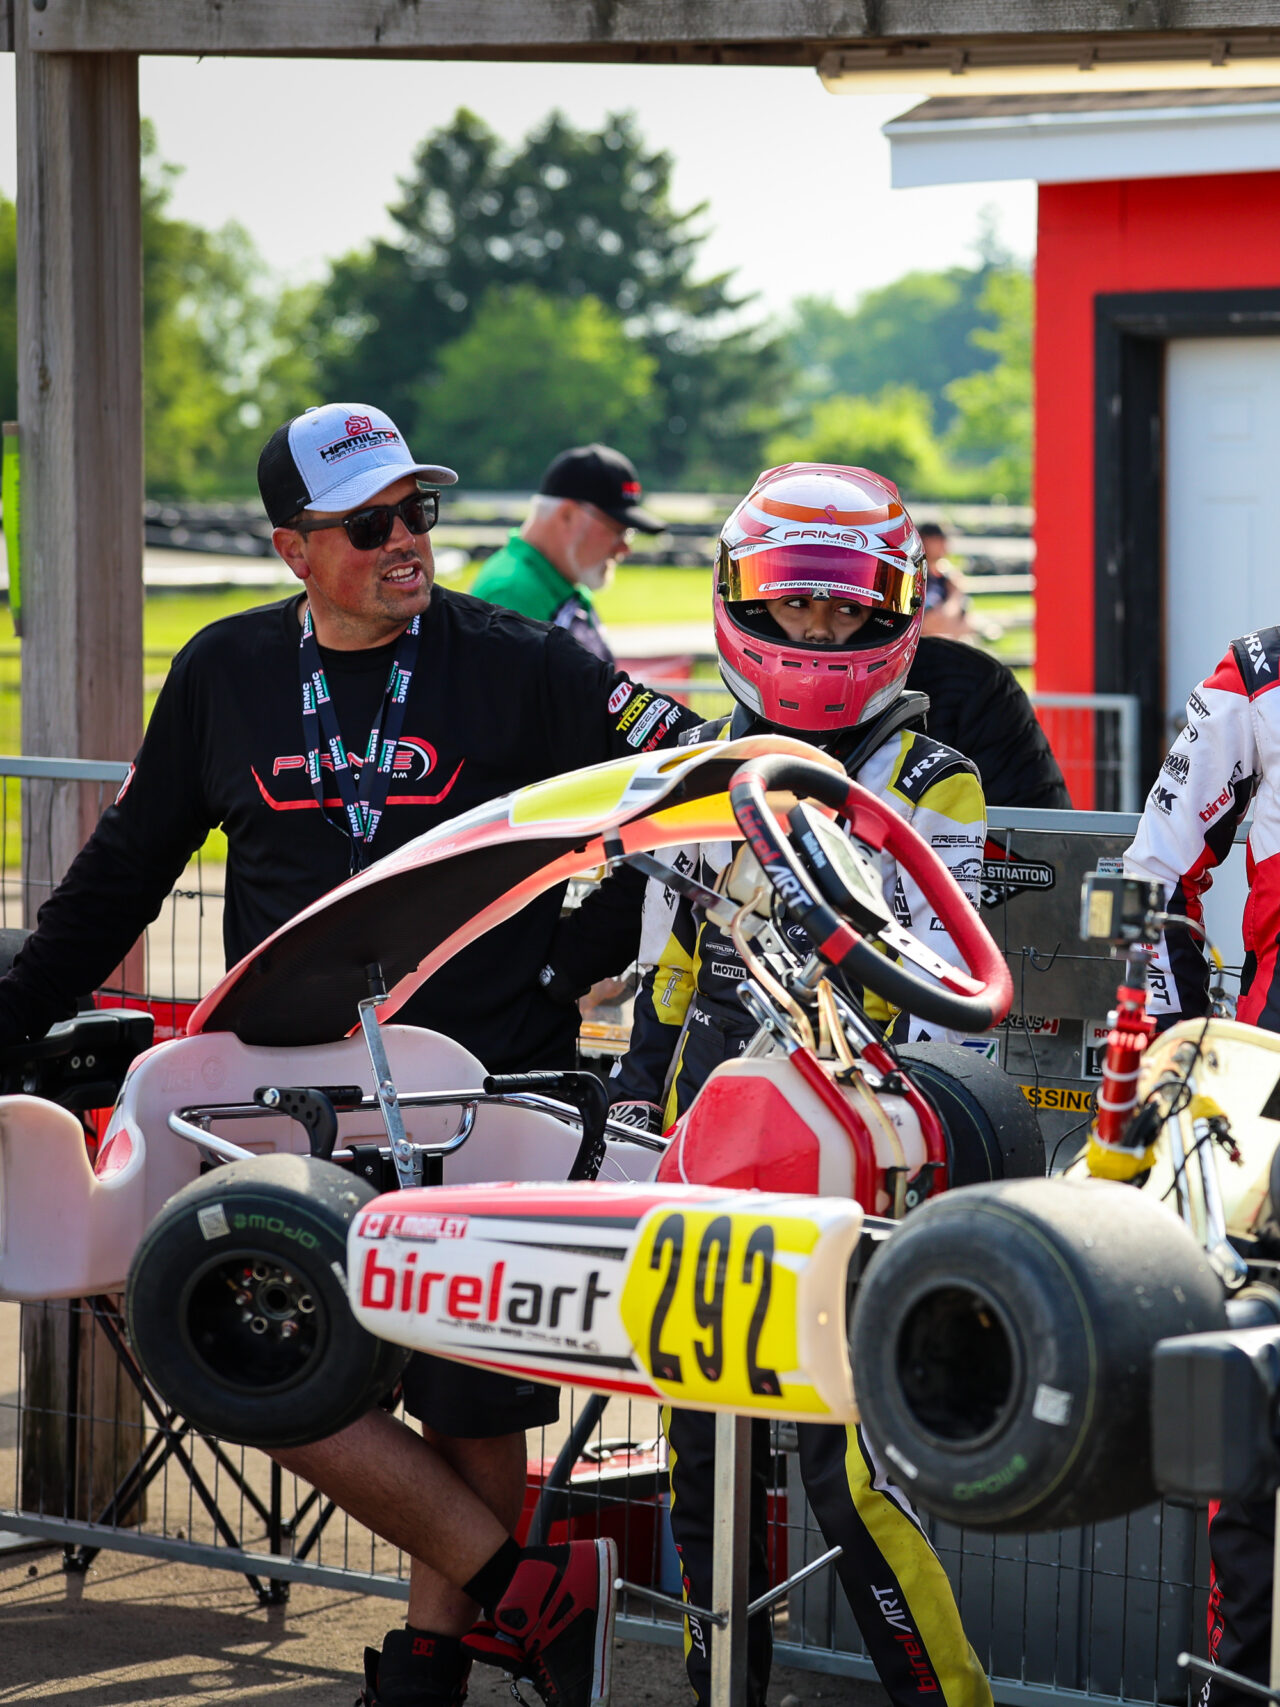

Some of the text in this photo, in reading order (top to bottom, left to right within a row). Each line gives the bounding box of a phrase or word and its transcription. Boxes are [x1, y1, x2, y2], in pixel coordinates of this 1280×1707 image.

[320, 431, 400, 459] HAMILTON
[784, 530, 858, 544] PRIME
[1244, 633, 1271, 674] HRX
[302, 682, 312, 710] RMC
[312, 672, 326, 700] RMC
[397, 675, 410, 704] RMC
[628, 699, 666, 744] FREELINE
[369, 733, 379, 764] RMC
[688, 728, 701, 745] HR
[307, 750, 318, 780] RMC
[328, 738, 342, 767] RMC
[383, 744, 397, 774] RMC
[902, 748, 951, 789] HRX
[346, 804, 360, 832] RMC
[366, 814, 381, 843] RMC
[931, 835, 984, 844] FREELIN
[736, 805, 815, 908] birelART
[987, 866, 1049, 882] STRATTON
[713, 964, 746, 979] MOTUL
[661, 969, 683, 1008] PRI
[360, 1248, 611, 1332] birelart
[650, 1213, 783, 1398] 292
[870, 1584, 939, 1693] birelART
